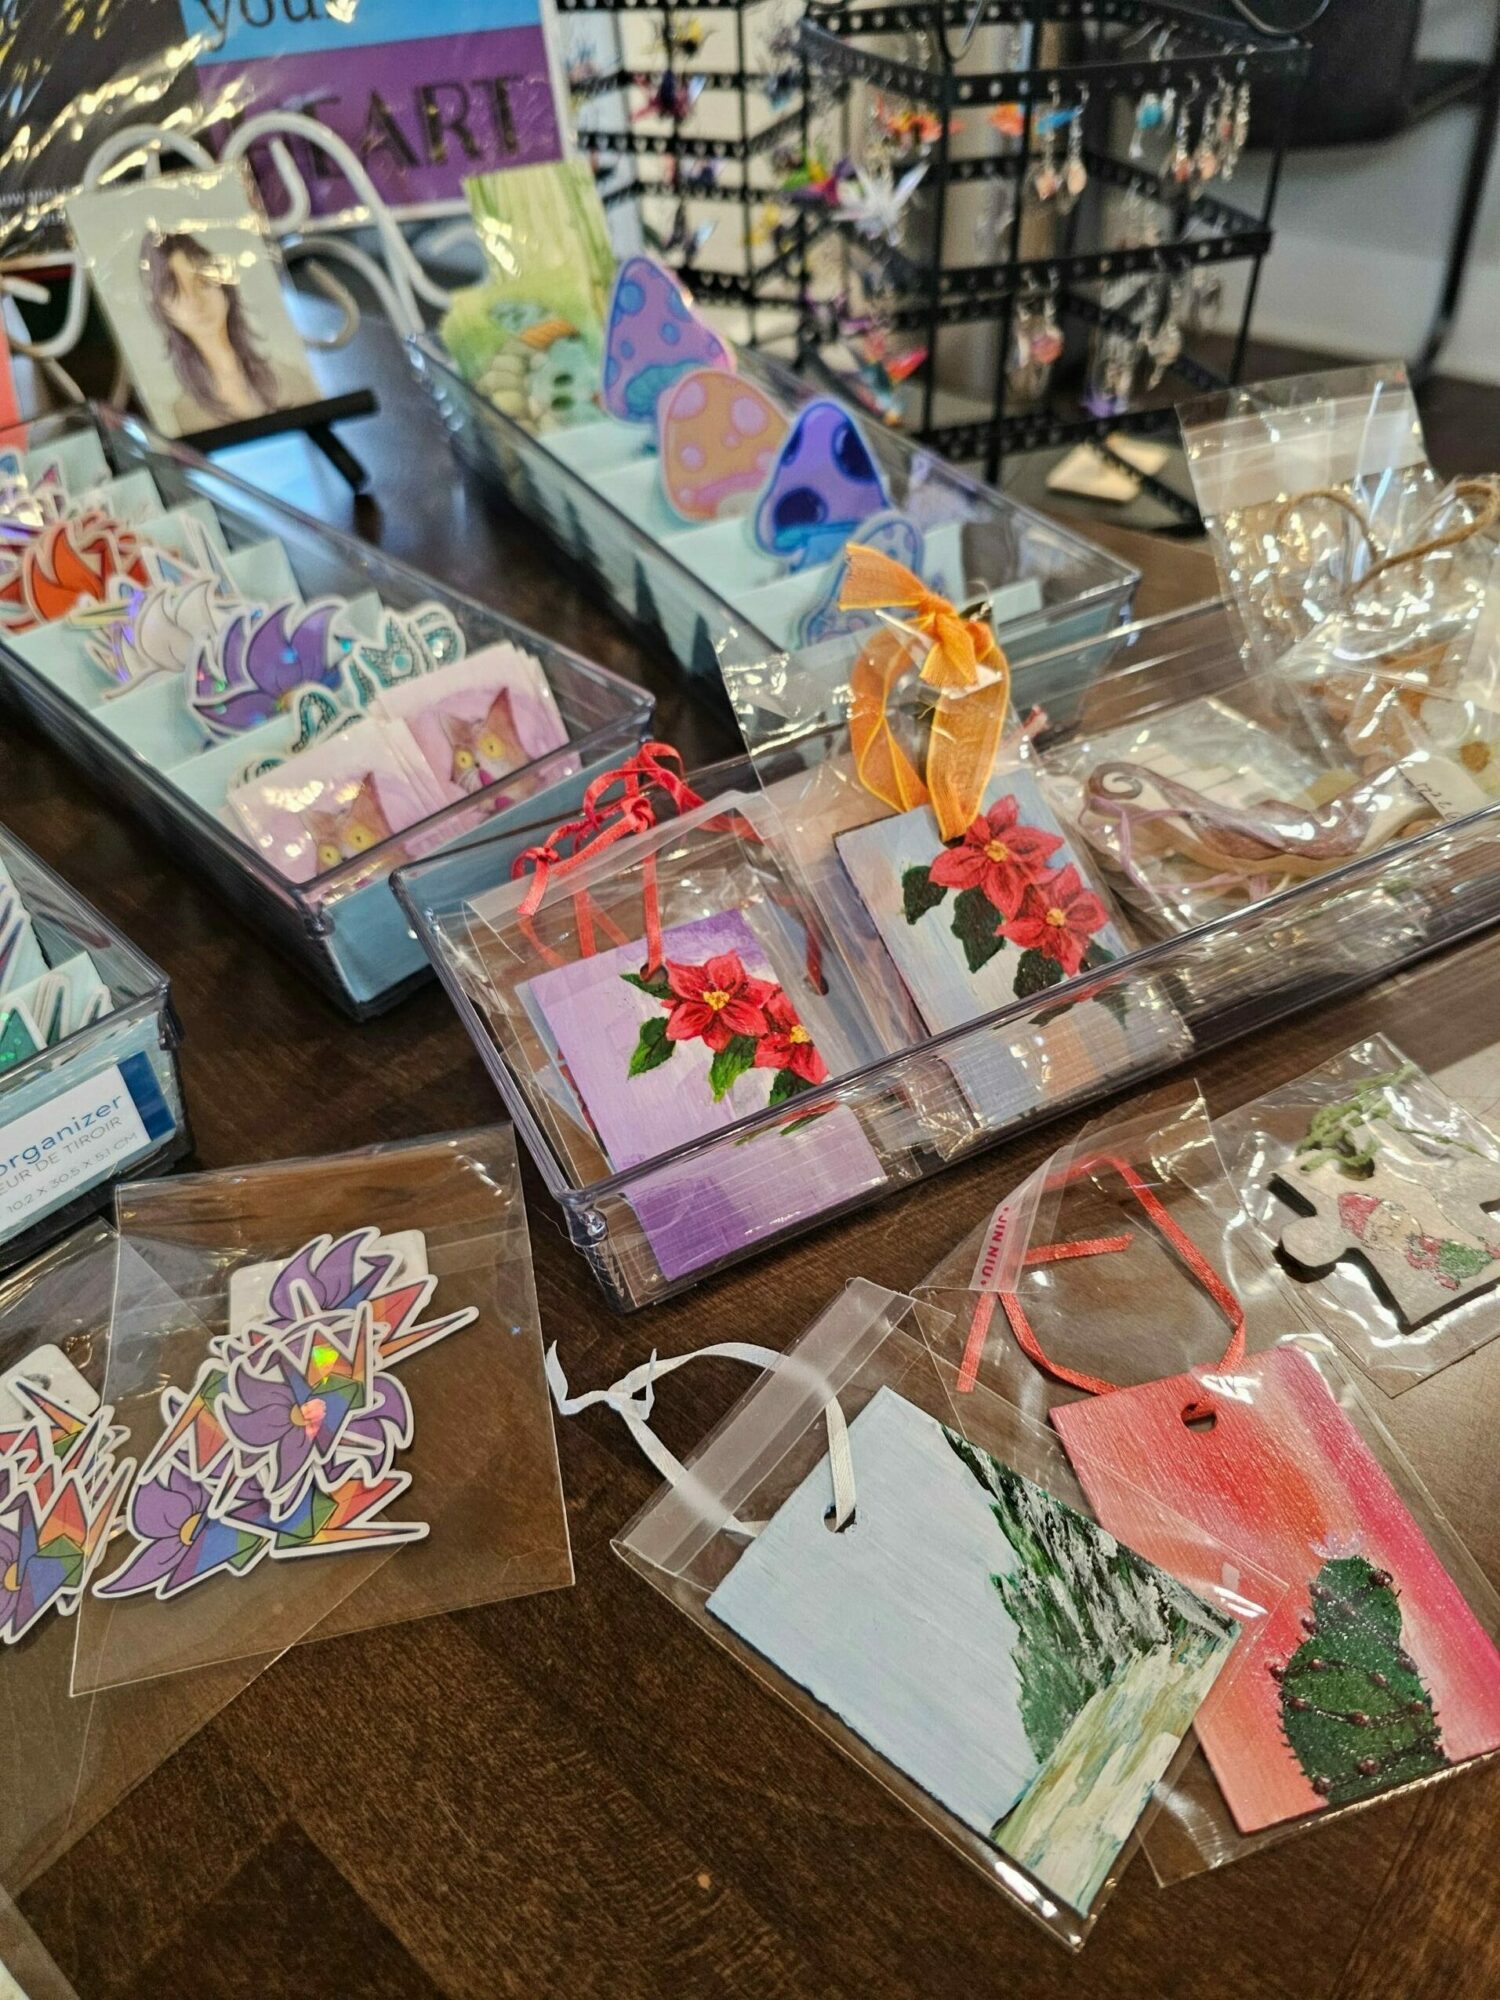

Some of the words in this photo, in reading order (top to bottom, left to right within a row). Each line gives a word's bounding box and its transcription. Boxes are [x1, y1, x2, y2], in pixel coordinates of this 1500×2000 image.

[0, 1095, 122, 1177] organizer
[35, 1152, 61, 1173] DE
[63, 1116, 122, 1155] TIROIR
[6, 1193, 33, 1213] 10.2
[51, 1167, 80, 1189] 30.5
[113, 1132, 138, 1151] CM
[991, 1214, 1008, 1243] JIN
[981, 1245, 1000, 1279] NIU
